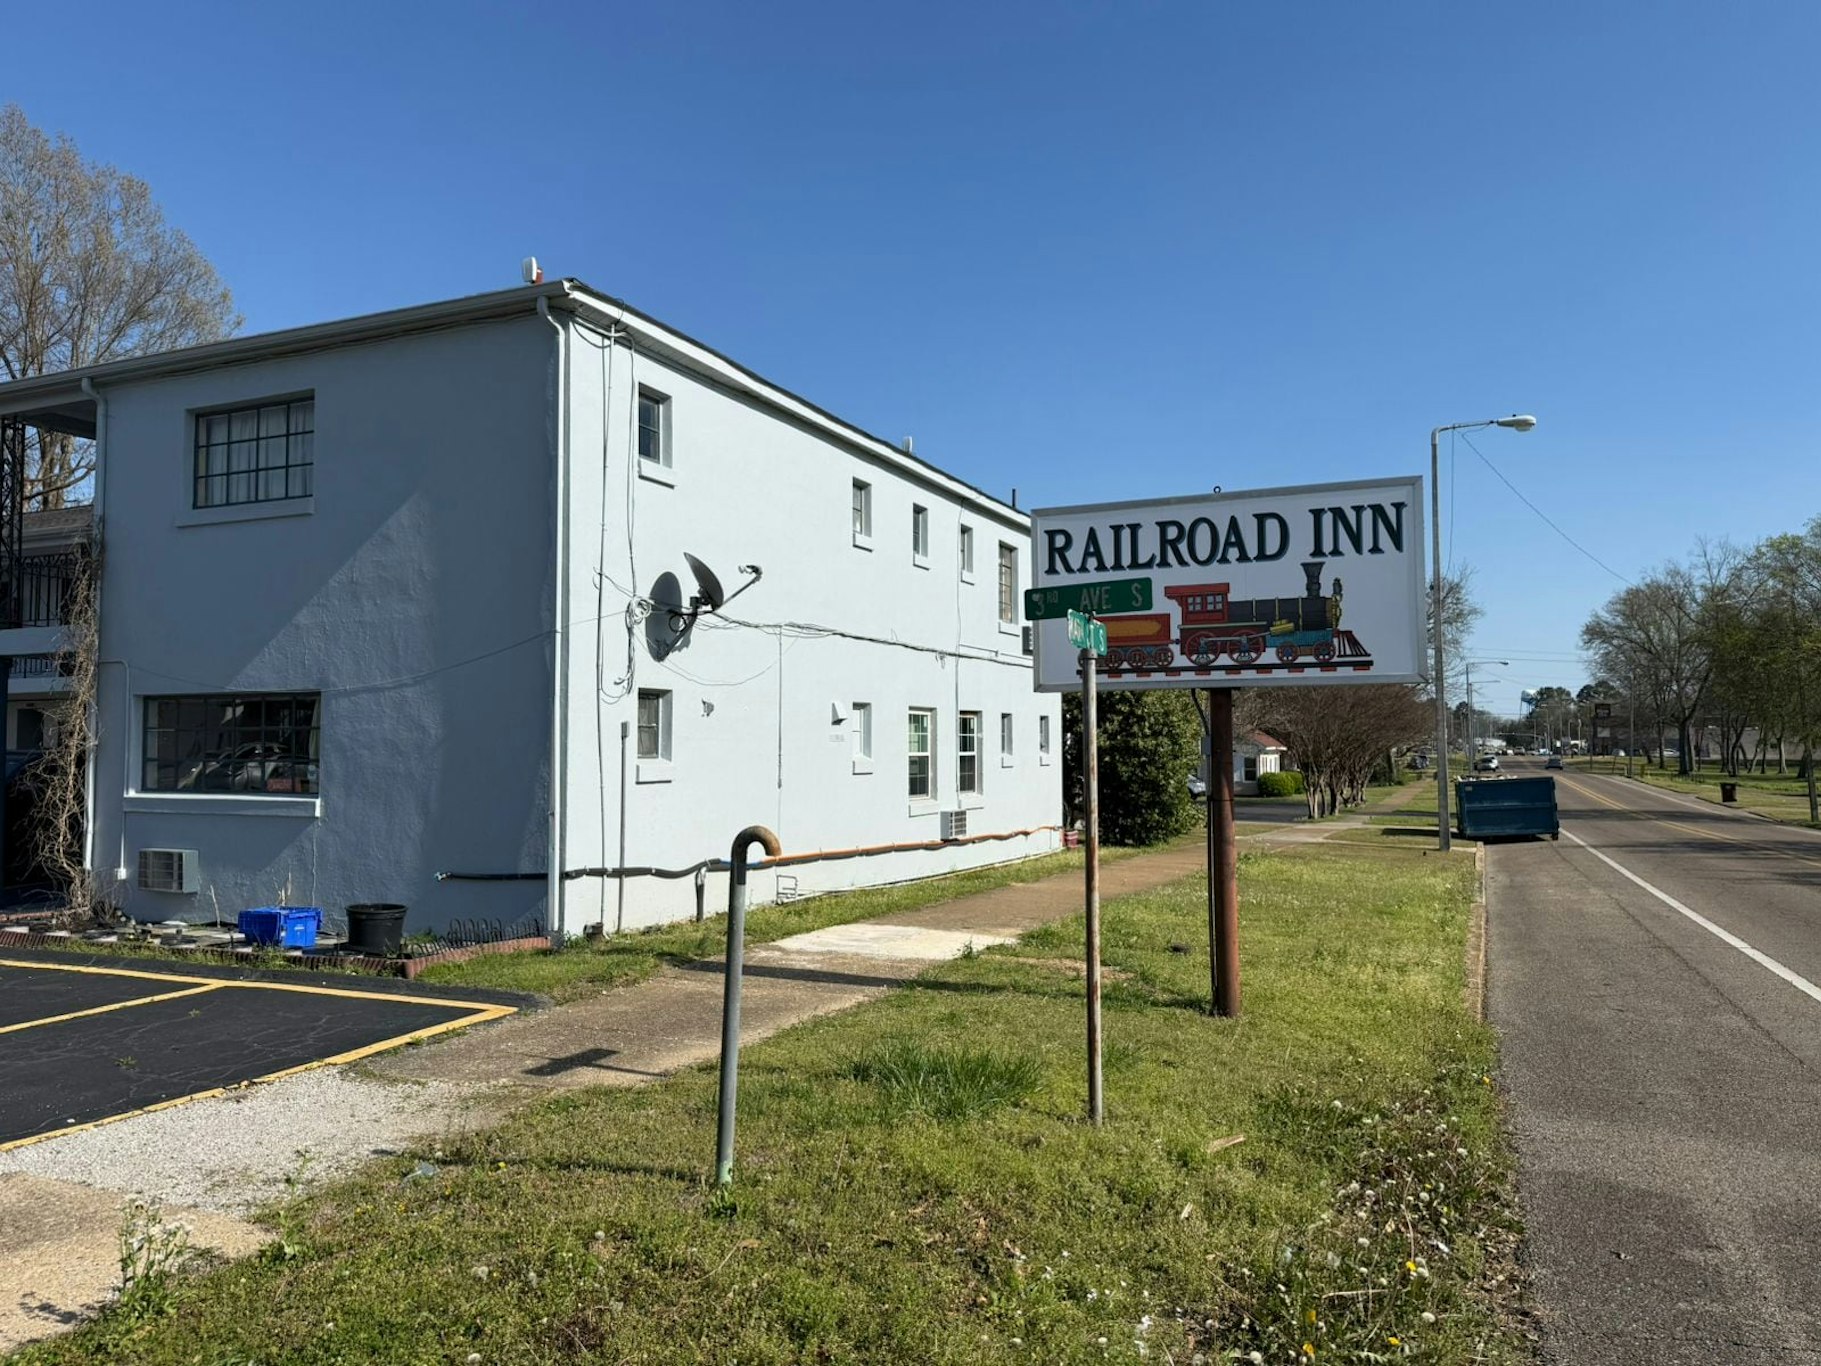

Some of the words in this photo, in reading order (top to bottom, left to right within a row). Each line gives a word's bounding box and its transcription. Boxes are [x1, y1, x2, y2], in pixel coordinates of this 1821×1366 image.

[1044, 512, 1290, 575] RAILROAD
[1309, 501, 1408, 558] INN
[1032, 590, 1059, 616] 3RD
[1080, 586, 1112, 611] AVE
[1131, 583, 1143, 607] S
